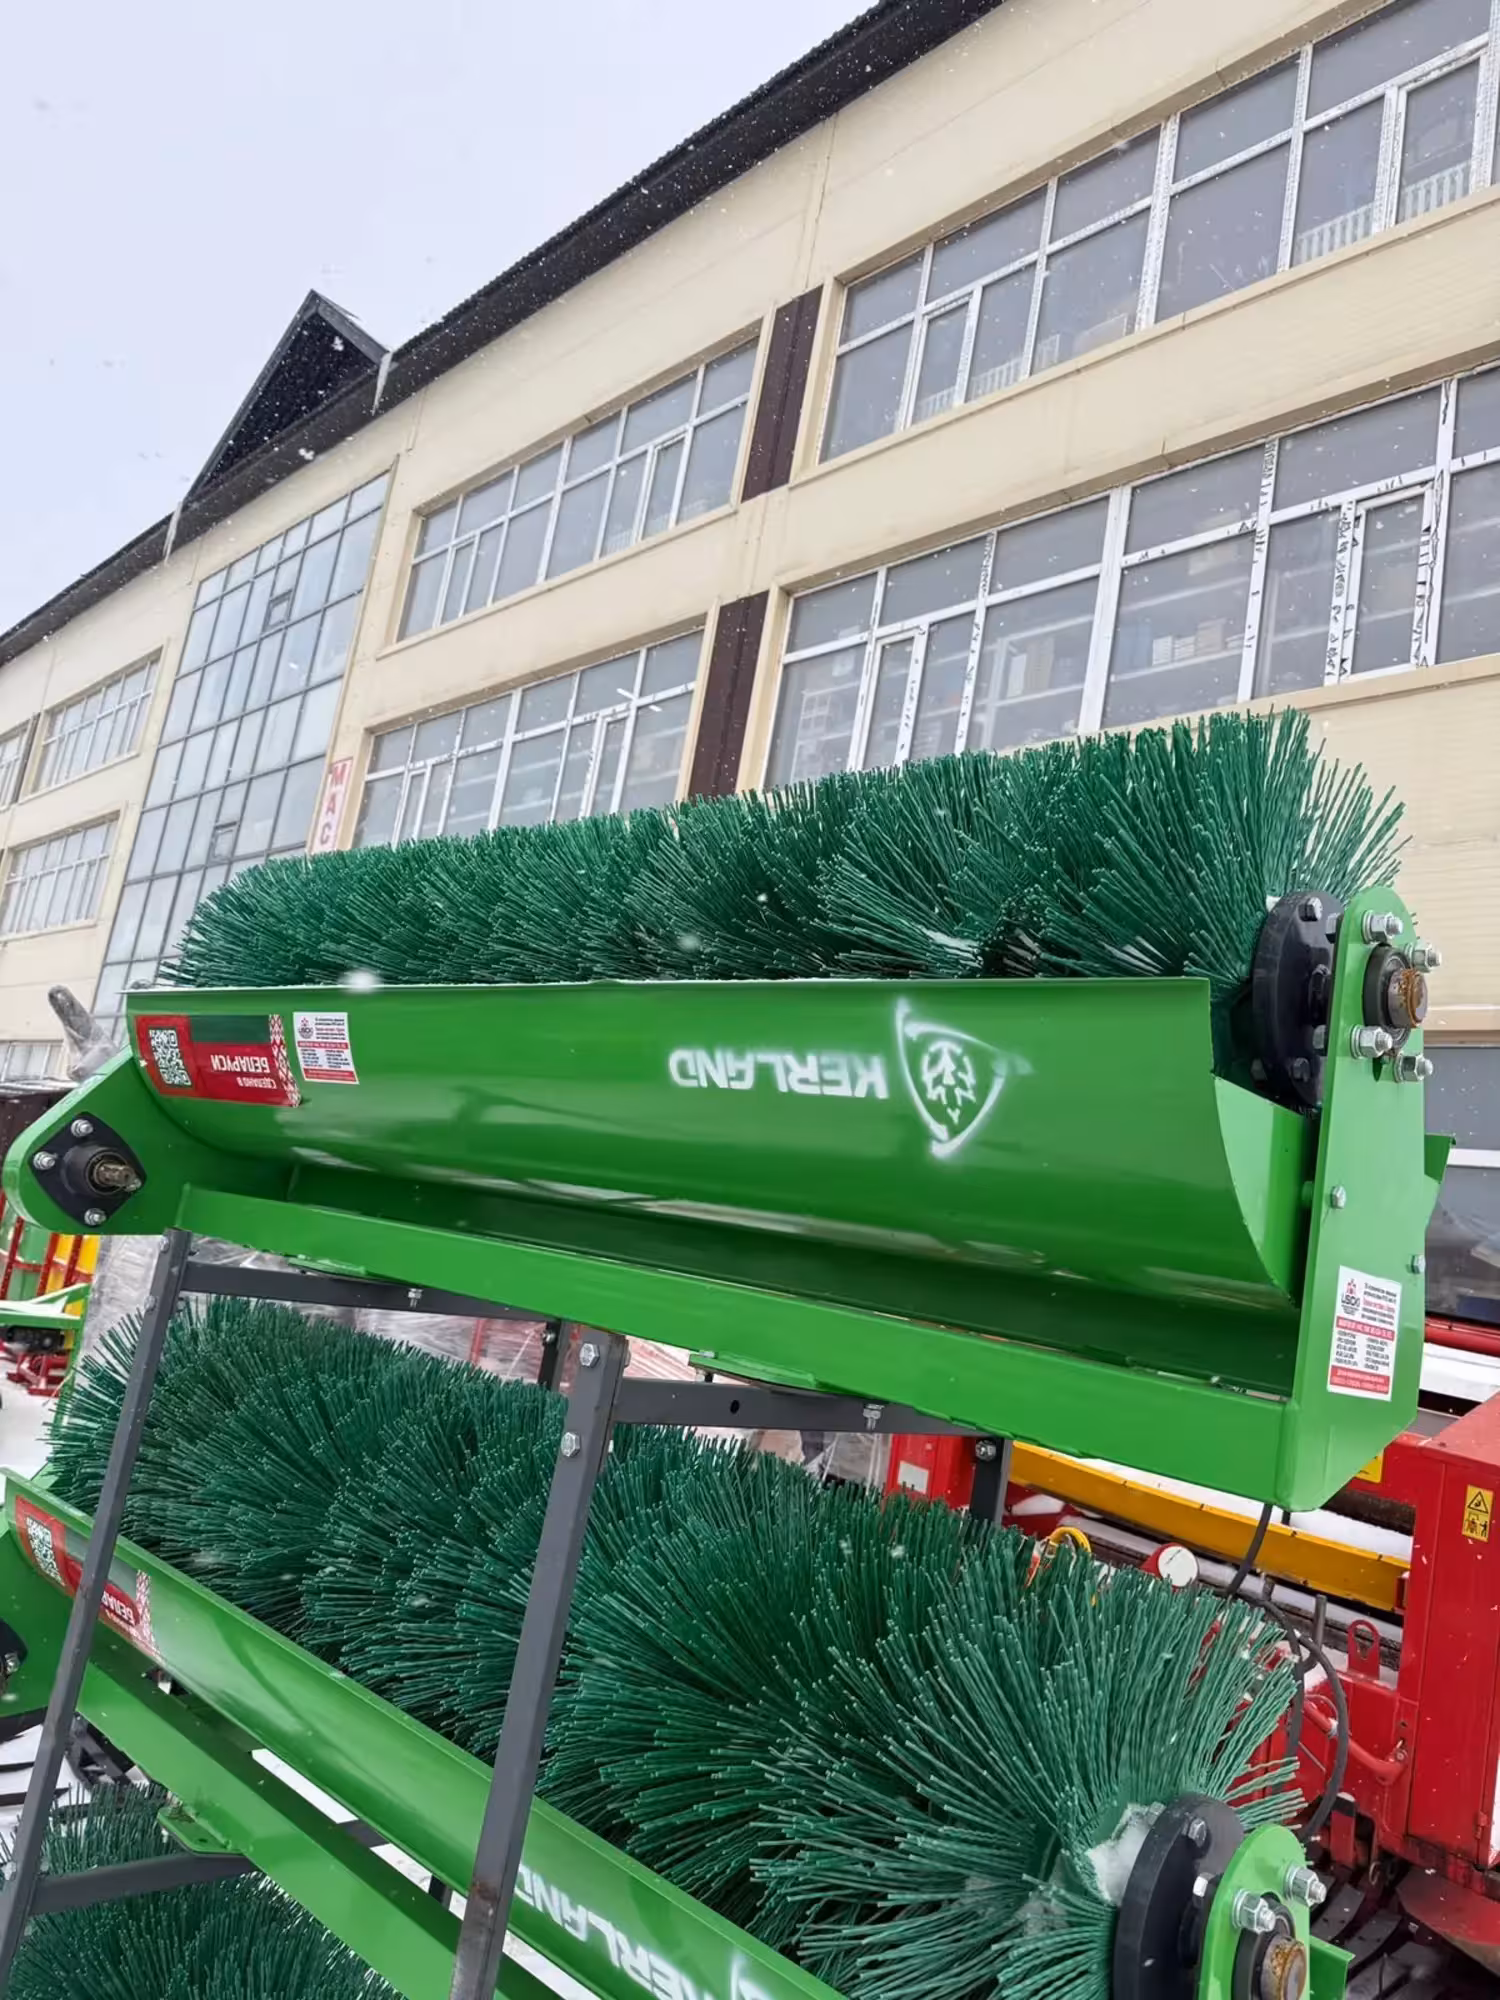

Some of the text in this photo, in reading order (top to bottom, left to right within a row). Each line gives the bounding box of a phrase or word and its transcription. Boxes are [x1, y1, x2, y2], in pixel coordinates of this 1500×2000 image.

[319, 763, 347, 846] МАС
[210, 1055, 271, 1073] БЕЛАРУСИ
[669, 1049, 888, 1099] KERLAND
[243, 1077, 277, 1089] СДЕЛАНО
